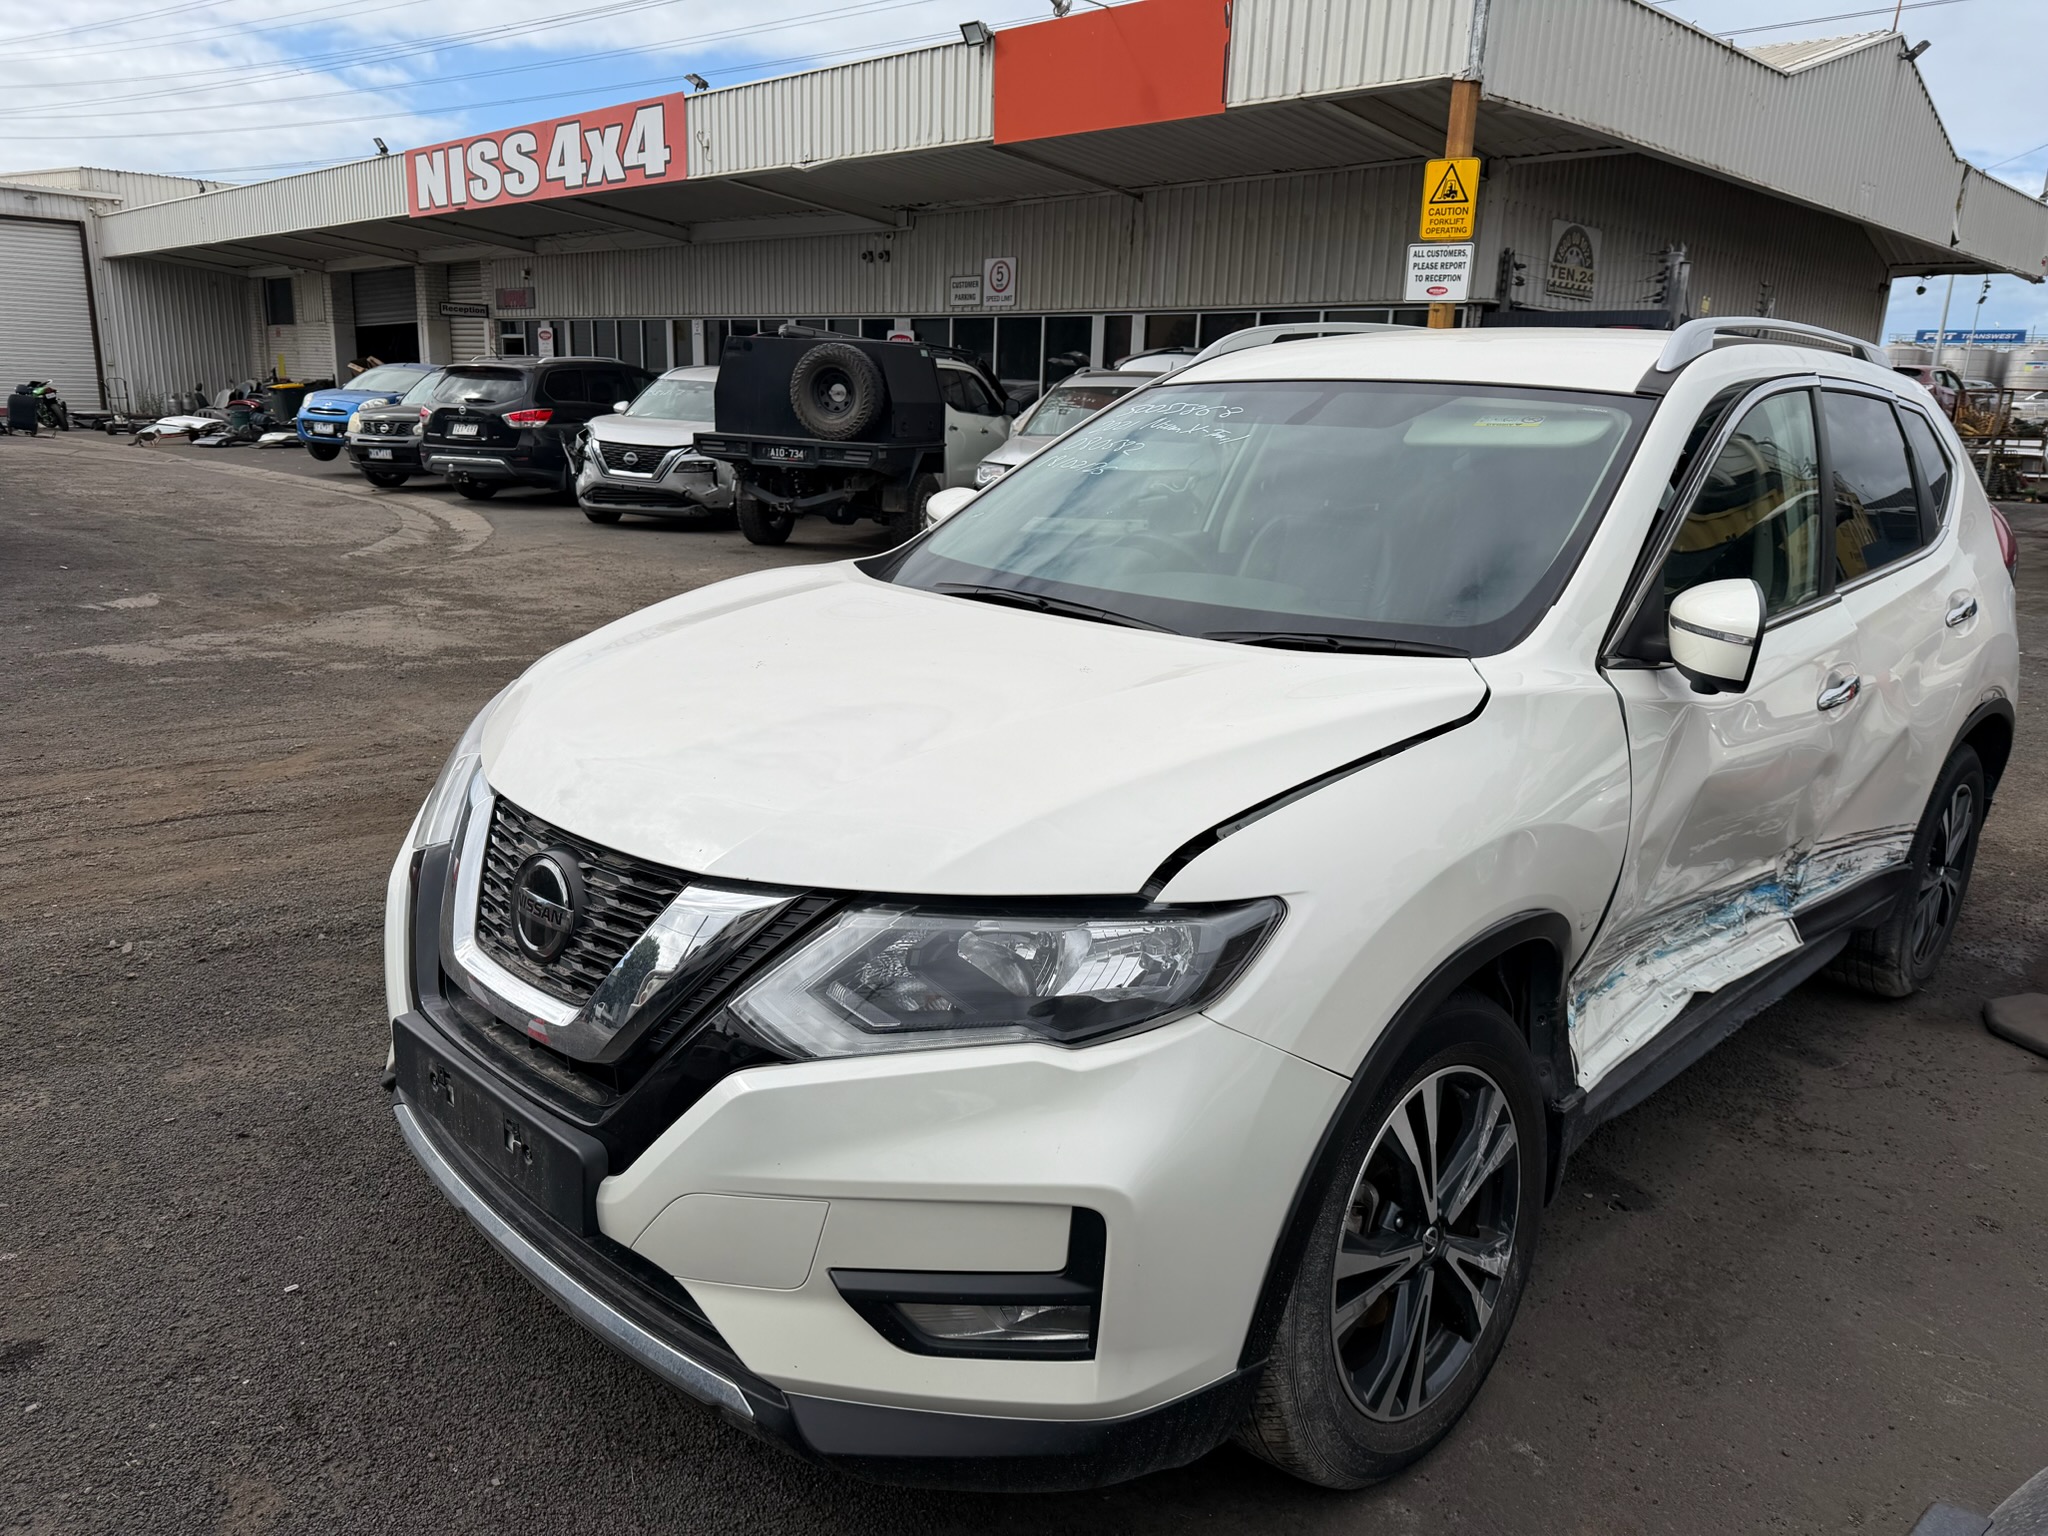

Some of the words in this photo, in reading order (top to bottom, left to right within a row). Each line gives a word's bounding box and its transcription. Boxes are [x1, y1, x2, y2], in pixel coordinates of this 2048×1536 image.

[414, 130, 540, 210] NISS
[546, 103, 672, 190] 4x4
[1428, 206, 1469, 217] CAUTION
[1425, 226, 1468, 234] OPERATING
[1412, 250, 1425, 258] ALL
[1426, 249, 1468, 258] CUSTOMERS,
[1412, 262, 1439, 270] PLEASE
[1440, 261, 1467, 270] REPORT
[996, 265, 1004, 282] 5
[1415, 274, 1424, 282] TO
[1425, 274, 1462, 282] RECEPTION
[952, 280, 979, 289] CUSTOMER
[954, 293, 976, 301] PARKING
[1001, 294, 1013, 302] LIMIT
[442, 304, 486, 314] Reception
[519, 895, 563, 925] NISSAN
